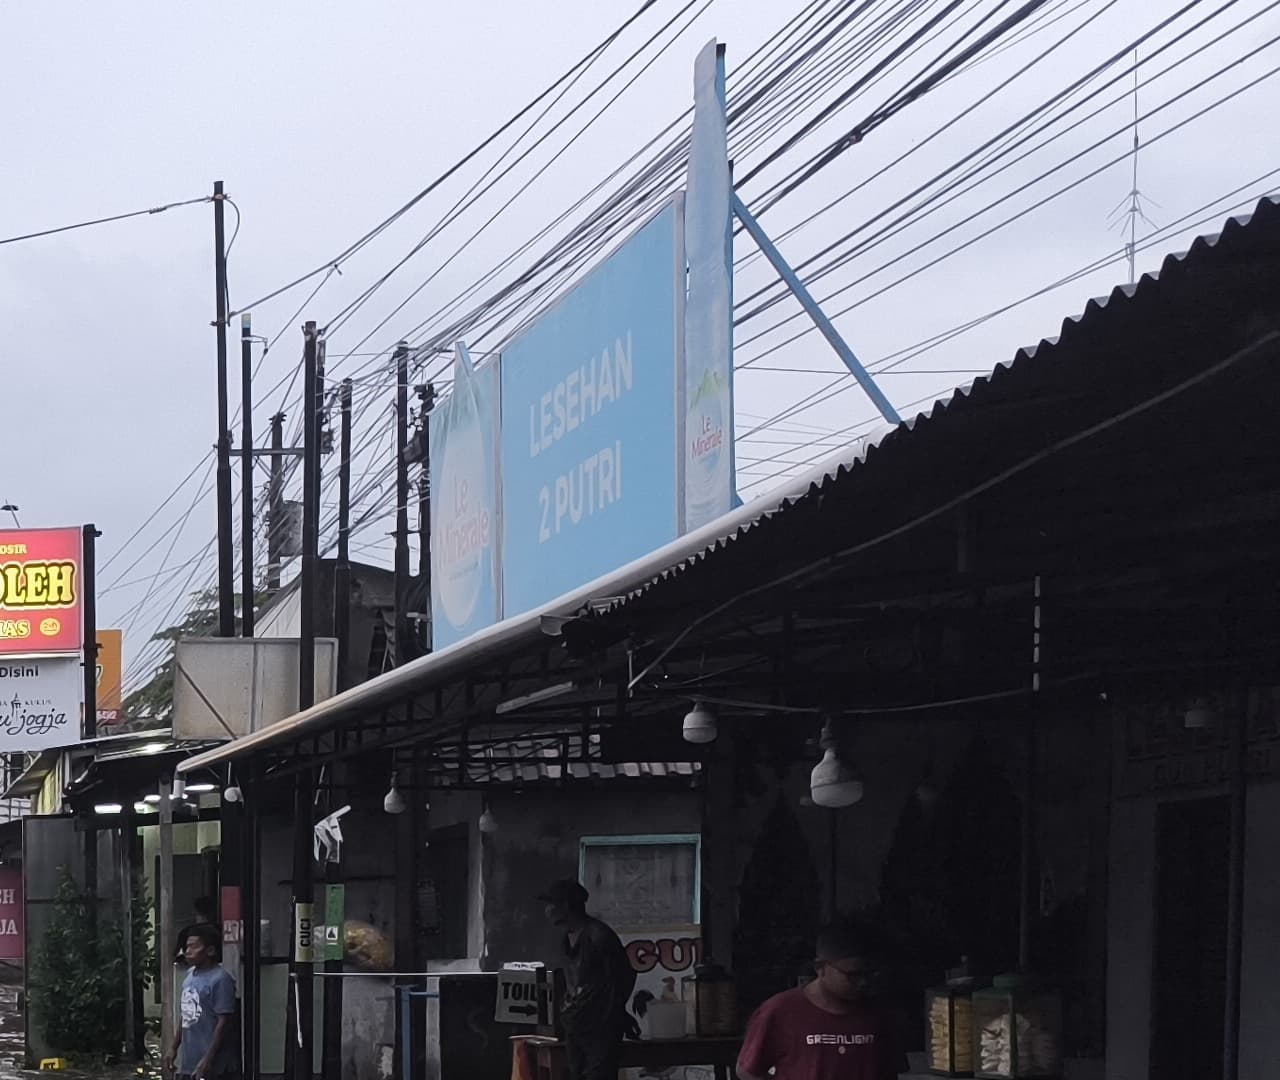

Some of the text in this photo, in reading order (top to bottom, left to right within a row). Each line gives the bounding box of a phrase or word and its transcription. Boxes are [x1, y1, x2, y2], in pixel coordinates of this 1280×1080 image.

[528, 329, 633, 458] LESEHAN
[538, 439, 623, 545] 2 PUTRI
[6, 708, 68, 736] jogja
[300, 918, 311, 947] CUCI
